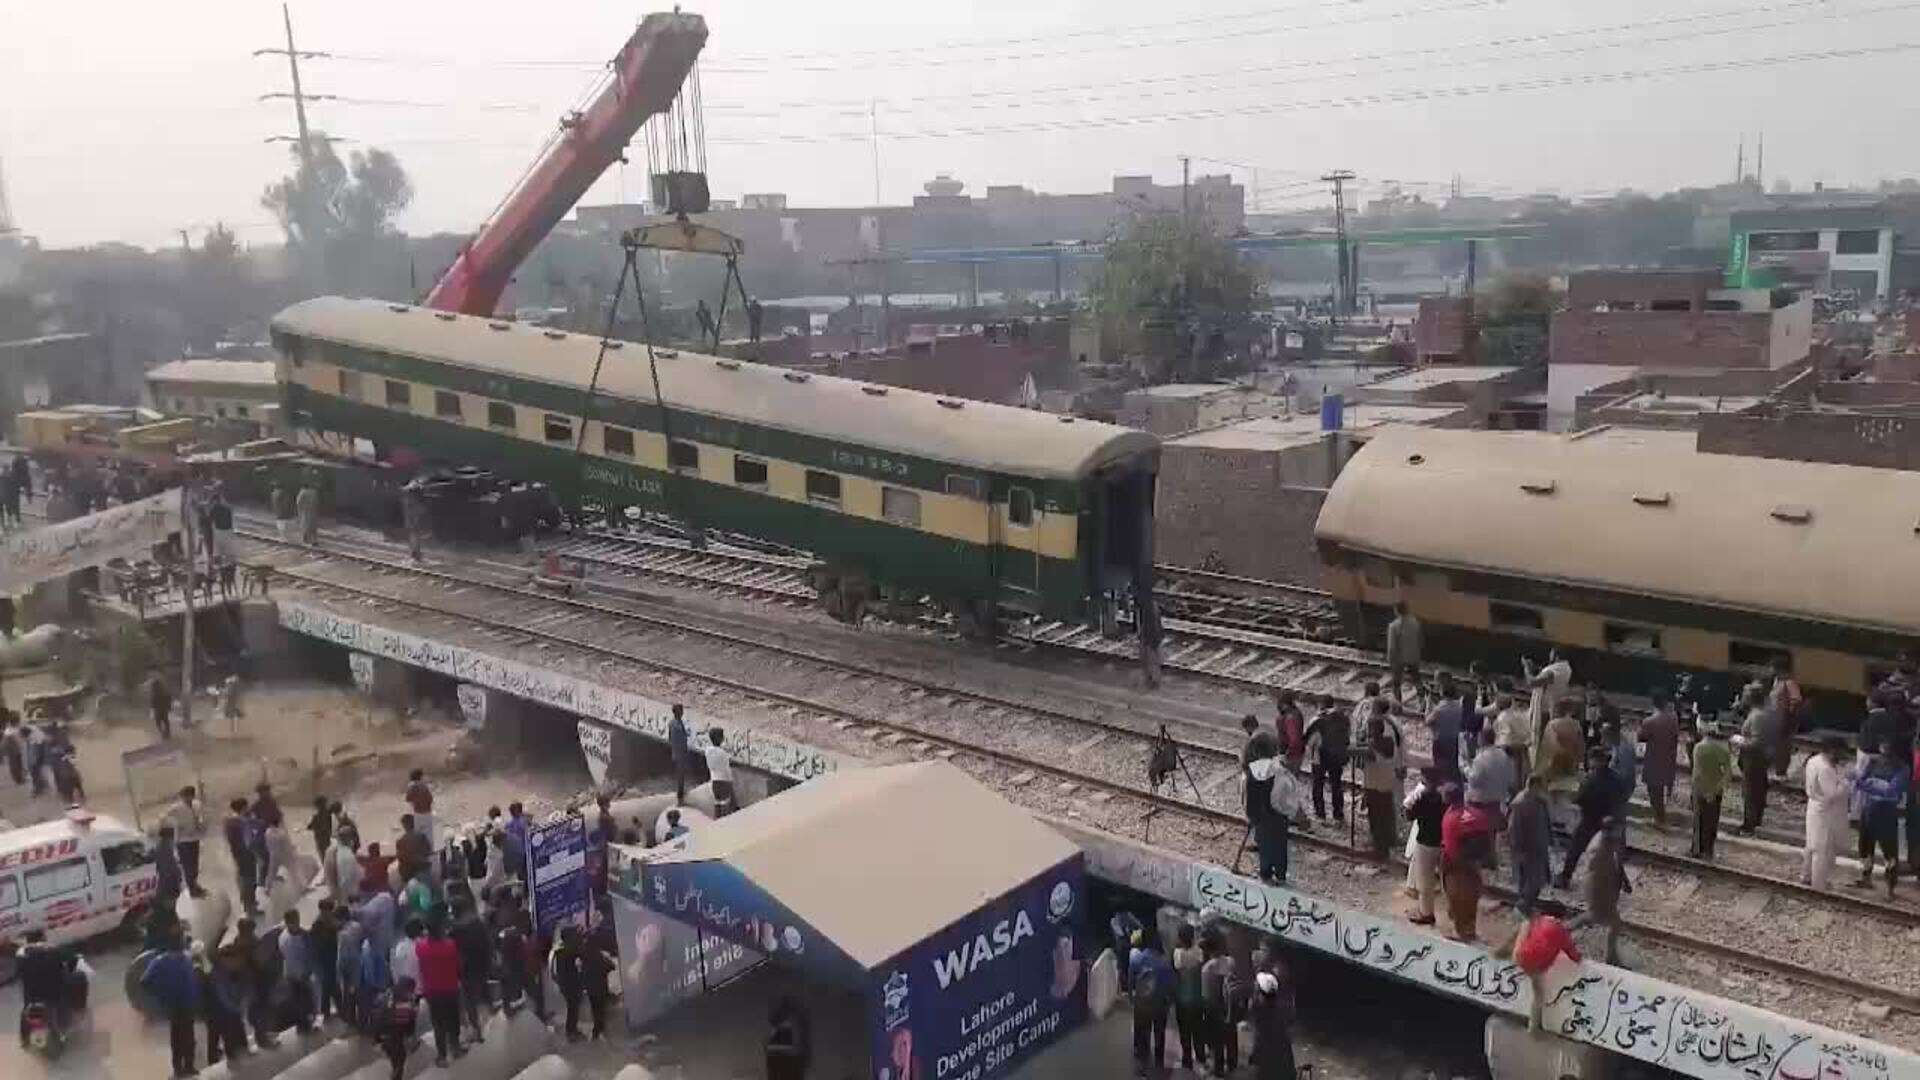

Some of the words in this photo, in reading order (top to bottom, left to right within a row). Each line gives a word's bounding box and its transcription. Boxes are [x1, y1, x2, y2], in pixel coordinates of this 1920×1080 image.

[933, 909, 1034, 989] WASA
[937, 998, 1038, 1077] Development
[961, 992, 1015, 1035] Lahore
[985, 1043, 1015, 1070] Site
[1018, 1011, 1060, 1047] Camp
